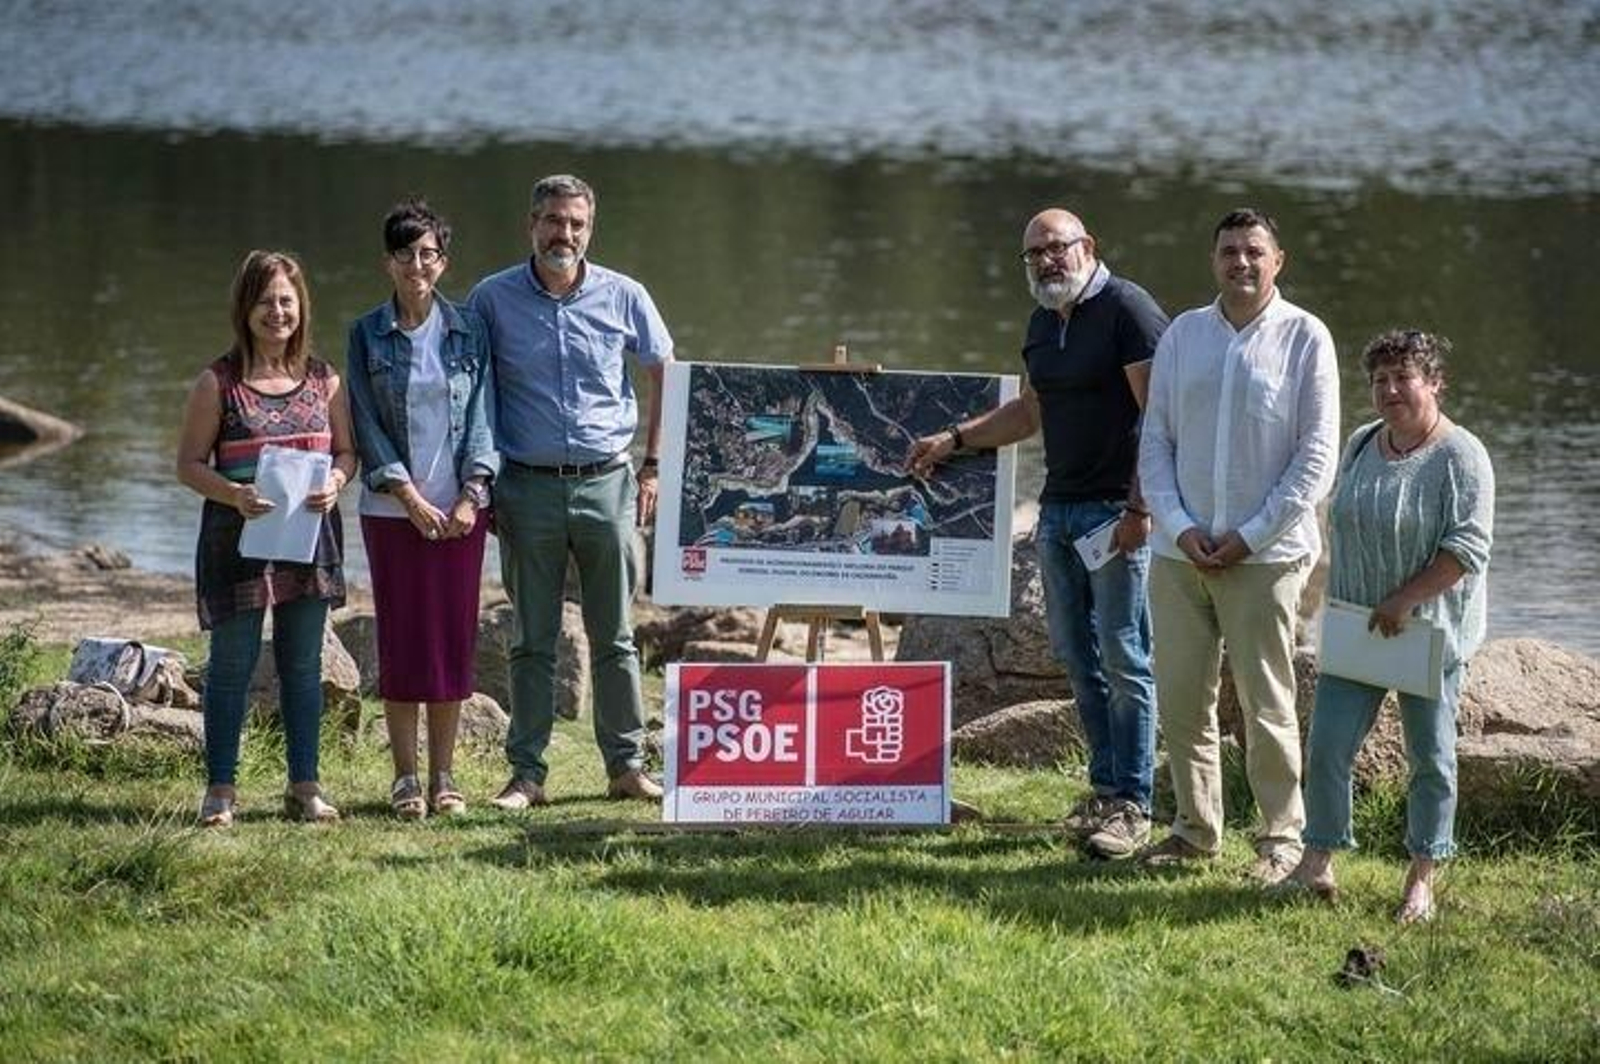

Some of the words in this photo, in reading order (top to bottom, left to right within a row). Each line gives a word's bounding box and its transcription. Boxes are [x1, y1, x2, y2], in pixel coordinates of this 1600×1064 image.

[687, 723, 799, 763] PSOE
[692, 790, 742, 804] GRUPO
[745, 790, 828, 804] MUNICIPAL
[834, 789, 927, 804] SOCIALISTA
[723, 808, 742, 820] DE
[746, 807, 809, 820] PEREIRO
[813, 807, 832, 820] DE
[836, 807, 895, 820] AGUIAR
